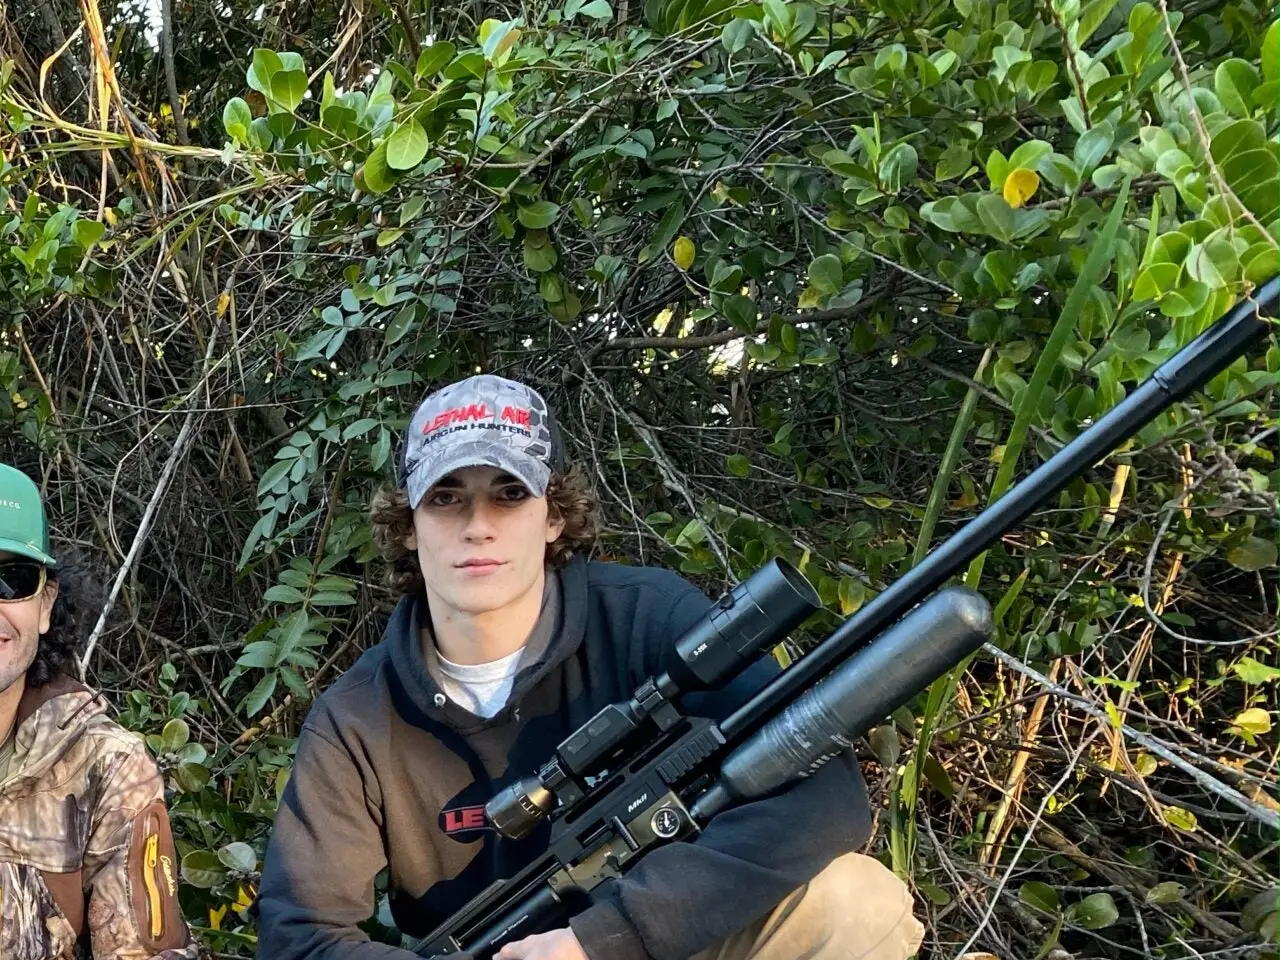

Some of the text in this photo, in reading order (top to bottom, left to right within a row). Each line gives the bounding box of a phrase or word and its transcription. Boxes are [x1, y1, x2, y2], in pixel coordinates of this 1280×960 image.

[423, 404, 531, 436] LETHAL AIR
[423, 422, 532, 446] AIRGUN HUNTERS
